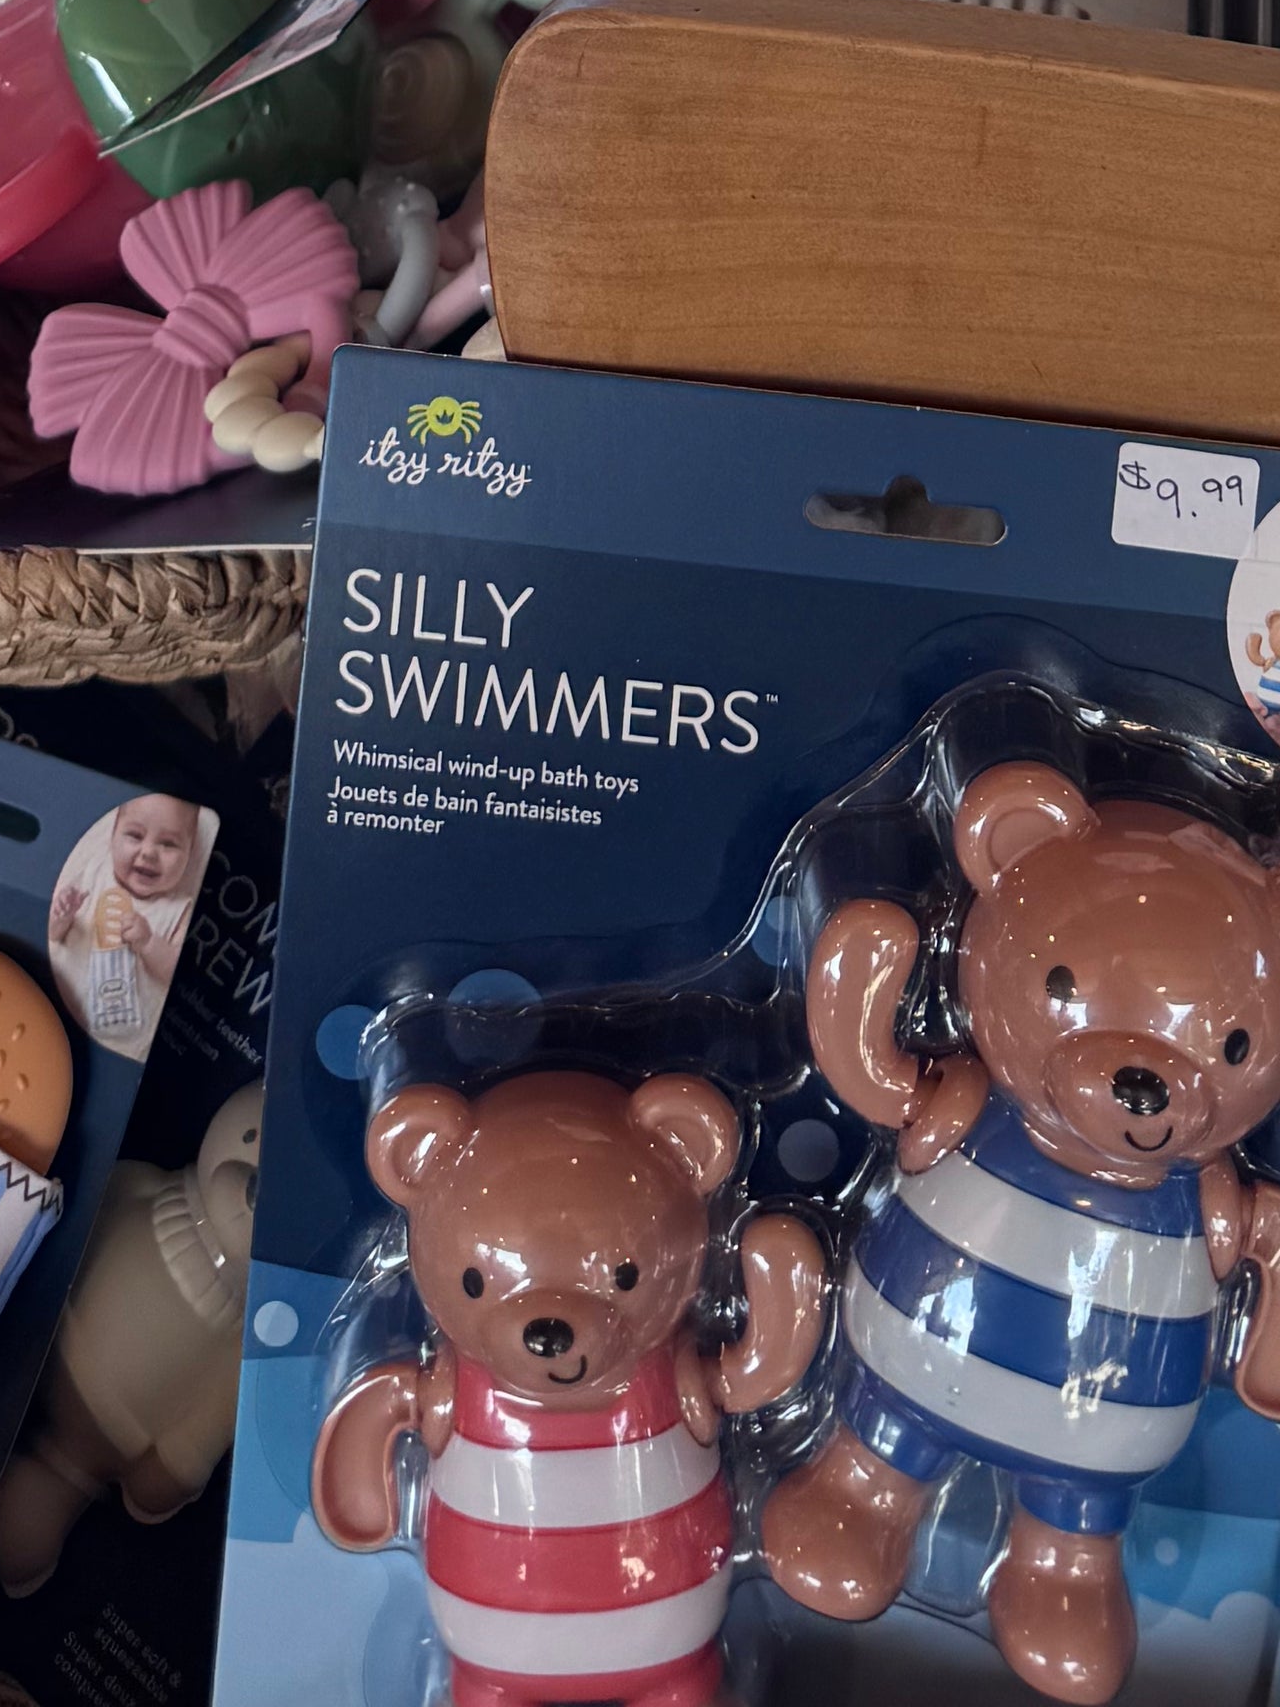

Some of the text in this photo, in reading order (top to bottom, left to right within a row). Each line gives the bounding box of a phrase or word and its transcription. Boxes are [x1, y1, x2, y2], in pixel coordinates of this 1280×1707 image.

[359, 427, 532, 498] itzy ritzy
[1119, 460, 1244, 519] $9.99
[343, 568, 534, 648] SILLY
[333, 738, 639, 800] Whimsical wind-up bath toys
[326, 776, 602, 827] Jouets de bain fantaisistes
[326, 802, 445, 836] à remonter
[186, 912, 273, 1016] REW
[216, 1017, 263, 1064] teether
